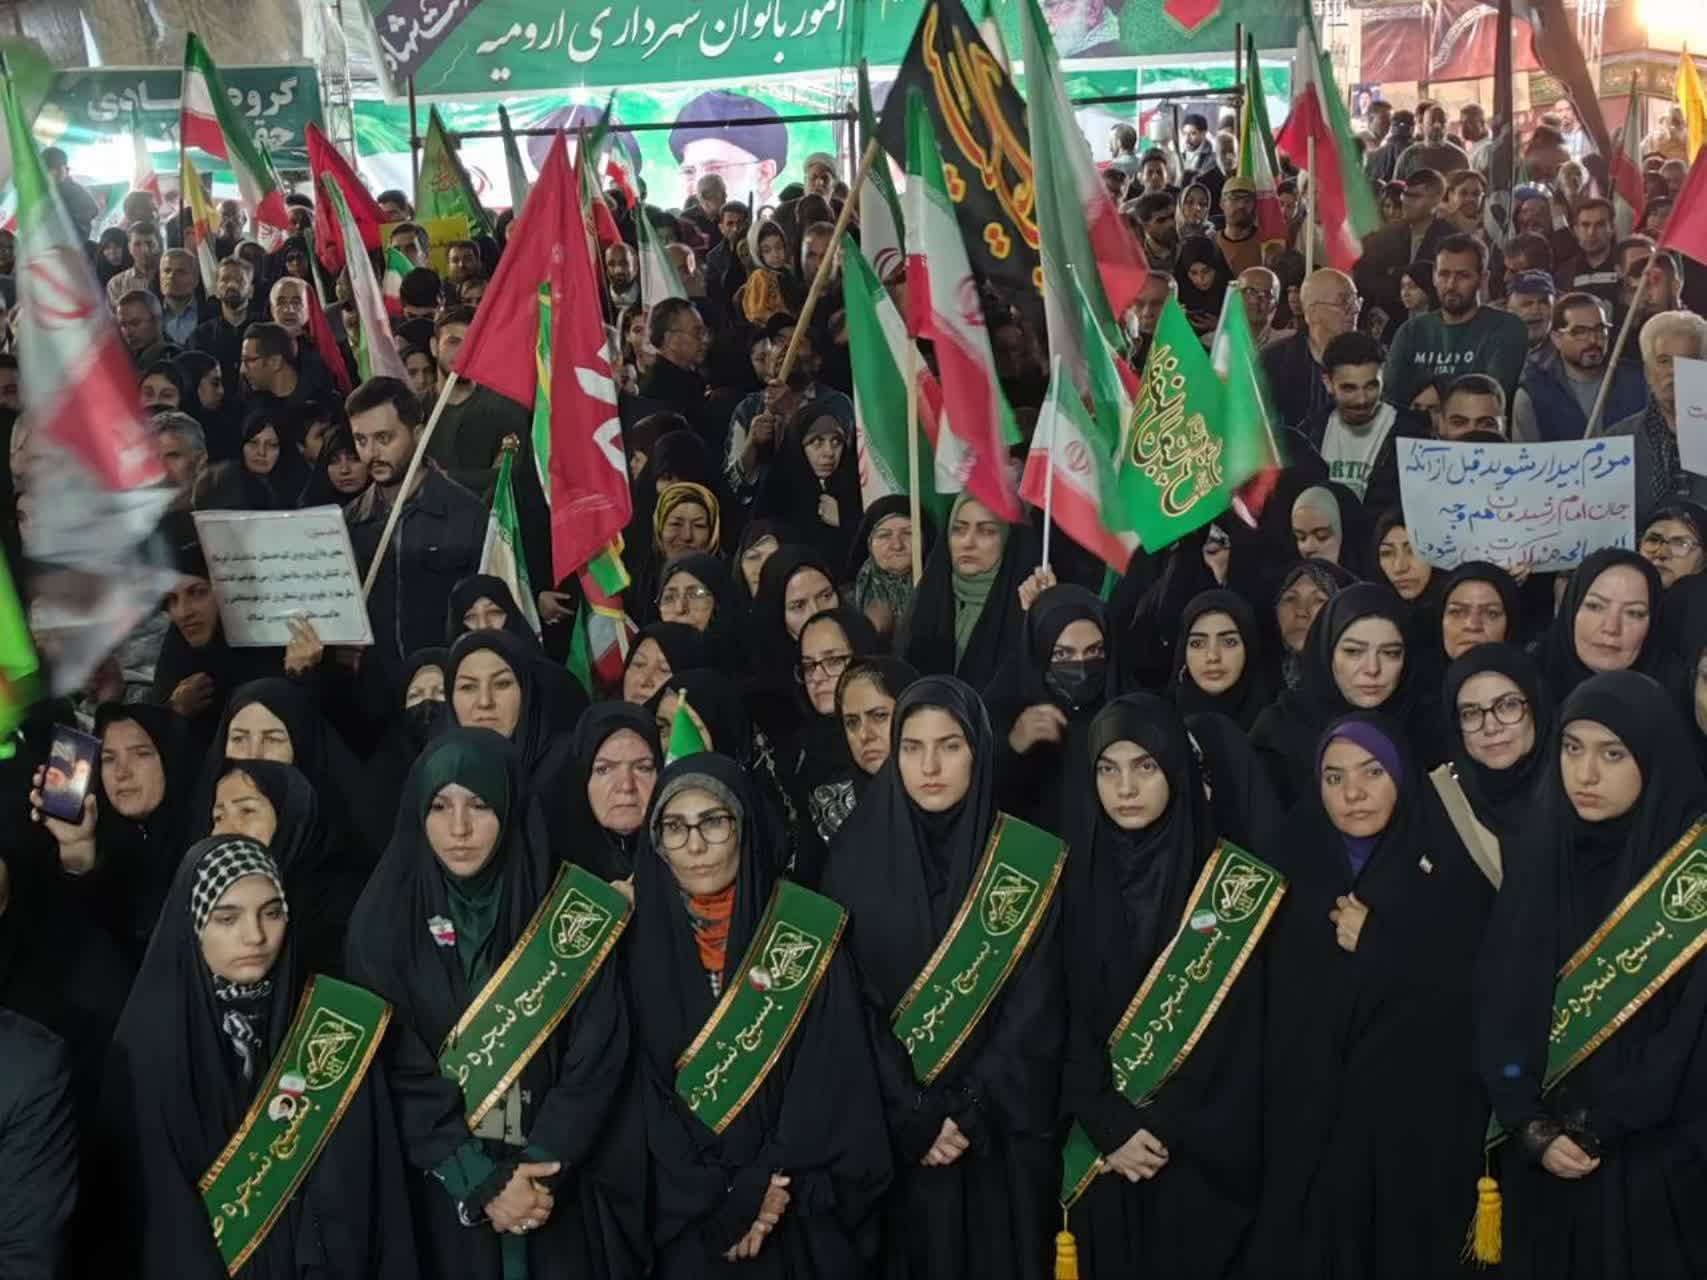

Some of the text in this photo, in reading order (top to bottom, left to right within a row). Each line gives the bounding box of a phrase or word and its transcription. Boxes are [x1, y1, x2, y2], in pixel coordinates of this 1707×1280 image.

[475, 9, 565, 81] ارومیه
[1446, 447, 1485, 485] قبل
[1528, 452, 1580, 489] بیدار
[1582, 441, 1631, 489] مردم
[952, 941, 1000, 995] بسیج
[1185, 927, 1232, 981] بسیج
[1616, 920, 1673, 974] بسیج
[514, 959, 567, 1017] بسیج
[734, 996, 784, 1051] بسیج
[269, 1096, 321, 1161] بسیج
